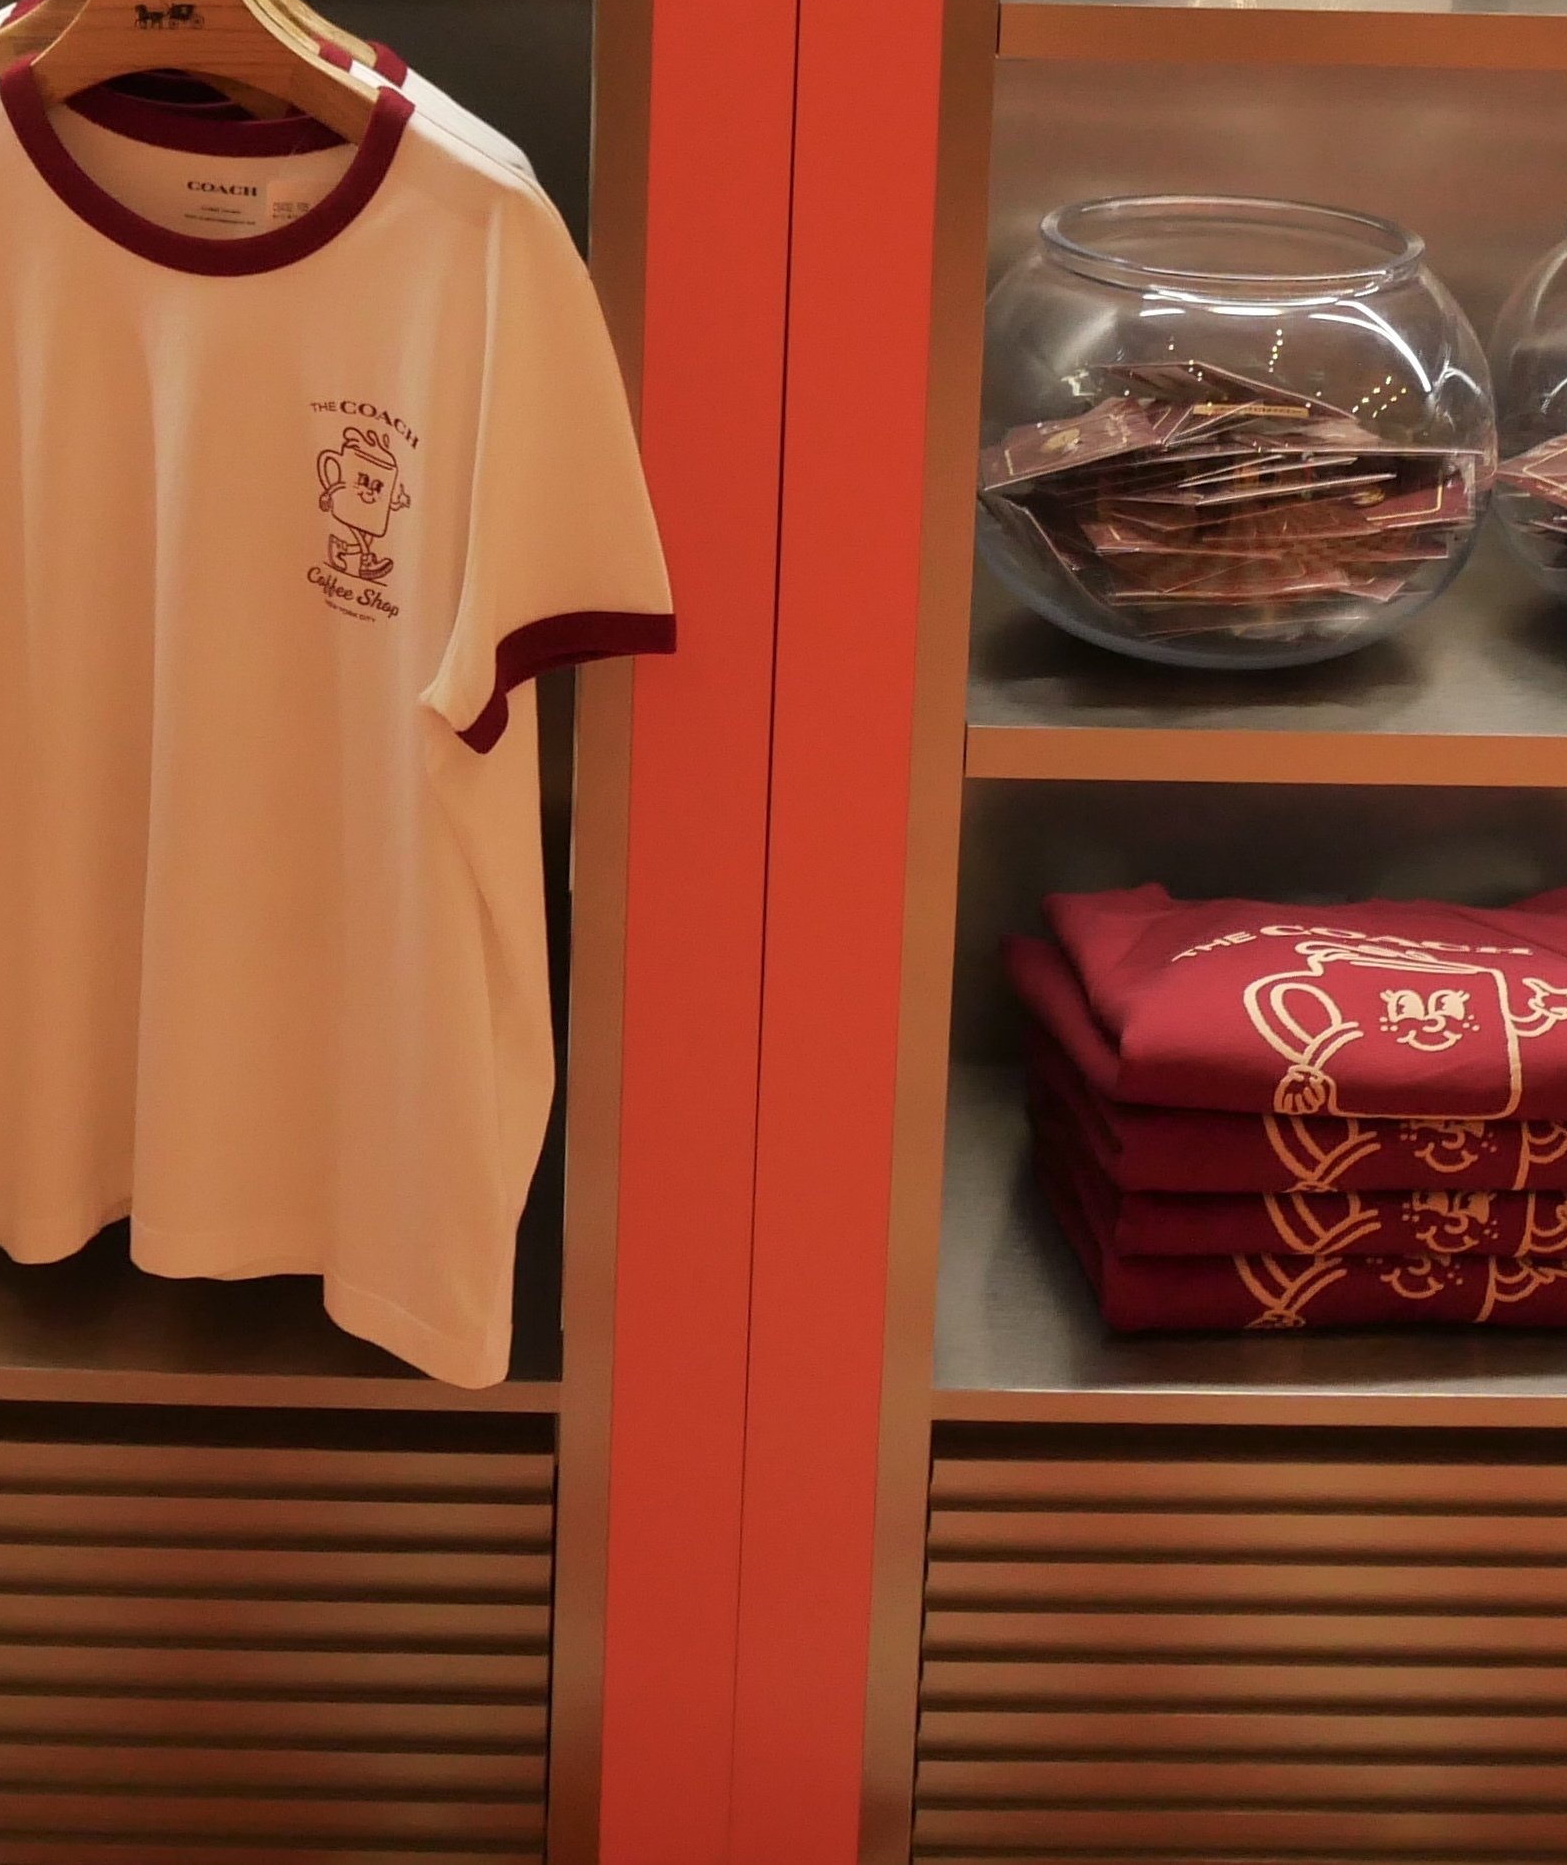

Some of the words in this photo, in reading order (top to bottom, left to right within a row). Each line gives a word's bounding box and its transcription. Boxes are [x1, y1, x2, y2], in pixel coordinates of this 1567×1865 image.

[187, 181, 257, 197] COACH
[310, 401, 337, 413] THE
[340, 400, 419, 450] COACH
[306, 566, 355, 598] Coffee
[356, 588, 400, 619] Shop
[1172, 931, 1257, 962] THE
[1260, 925, 1535, 956] COACH
